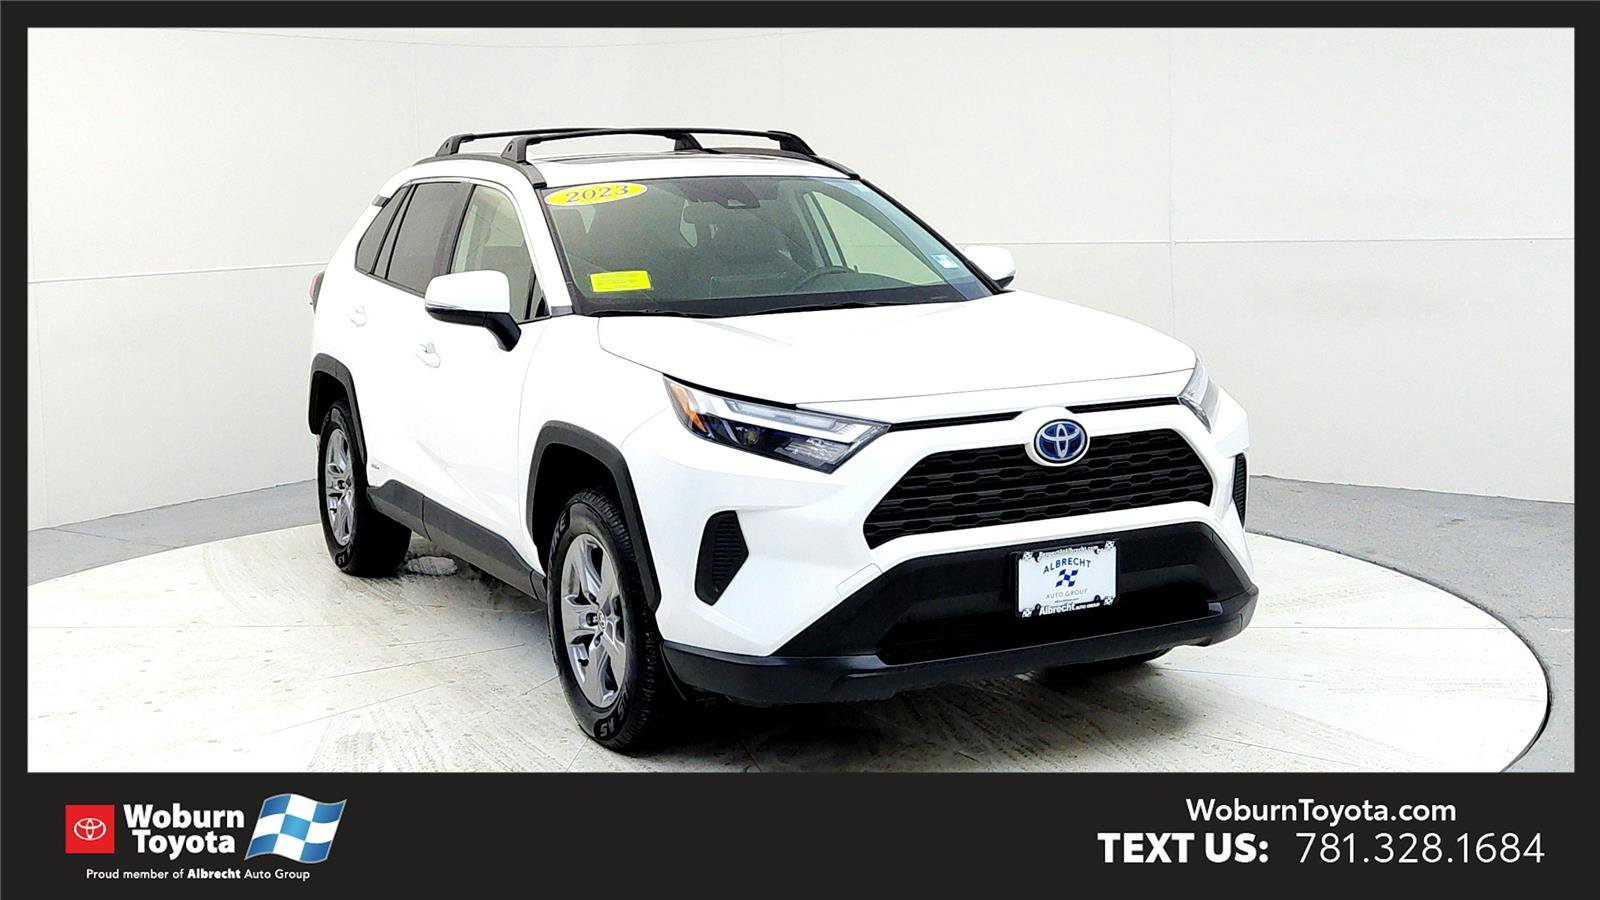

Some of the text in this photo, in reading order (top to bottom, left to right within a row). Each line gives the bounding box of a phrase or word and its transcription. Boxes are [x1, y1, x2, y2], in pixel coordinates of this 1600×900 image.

[566, 185, 629, 203] 2023
[1042, 557, 1092, 575] ALBRECHT
[1045, 591, 1064, 599] AUTO
[1039, 603, 1075, 616] Albrecht
